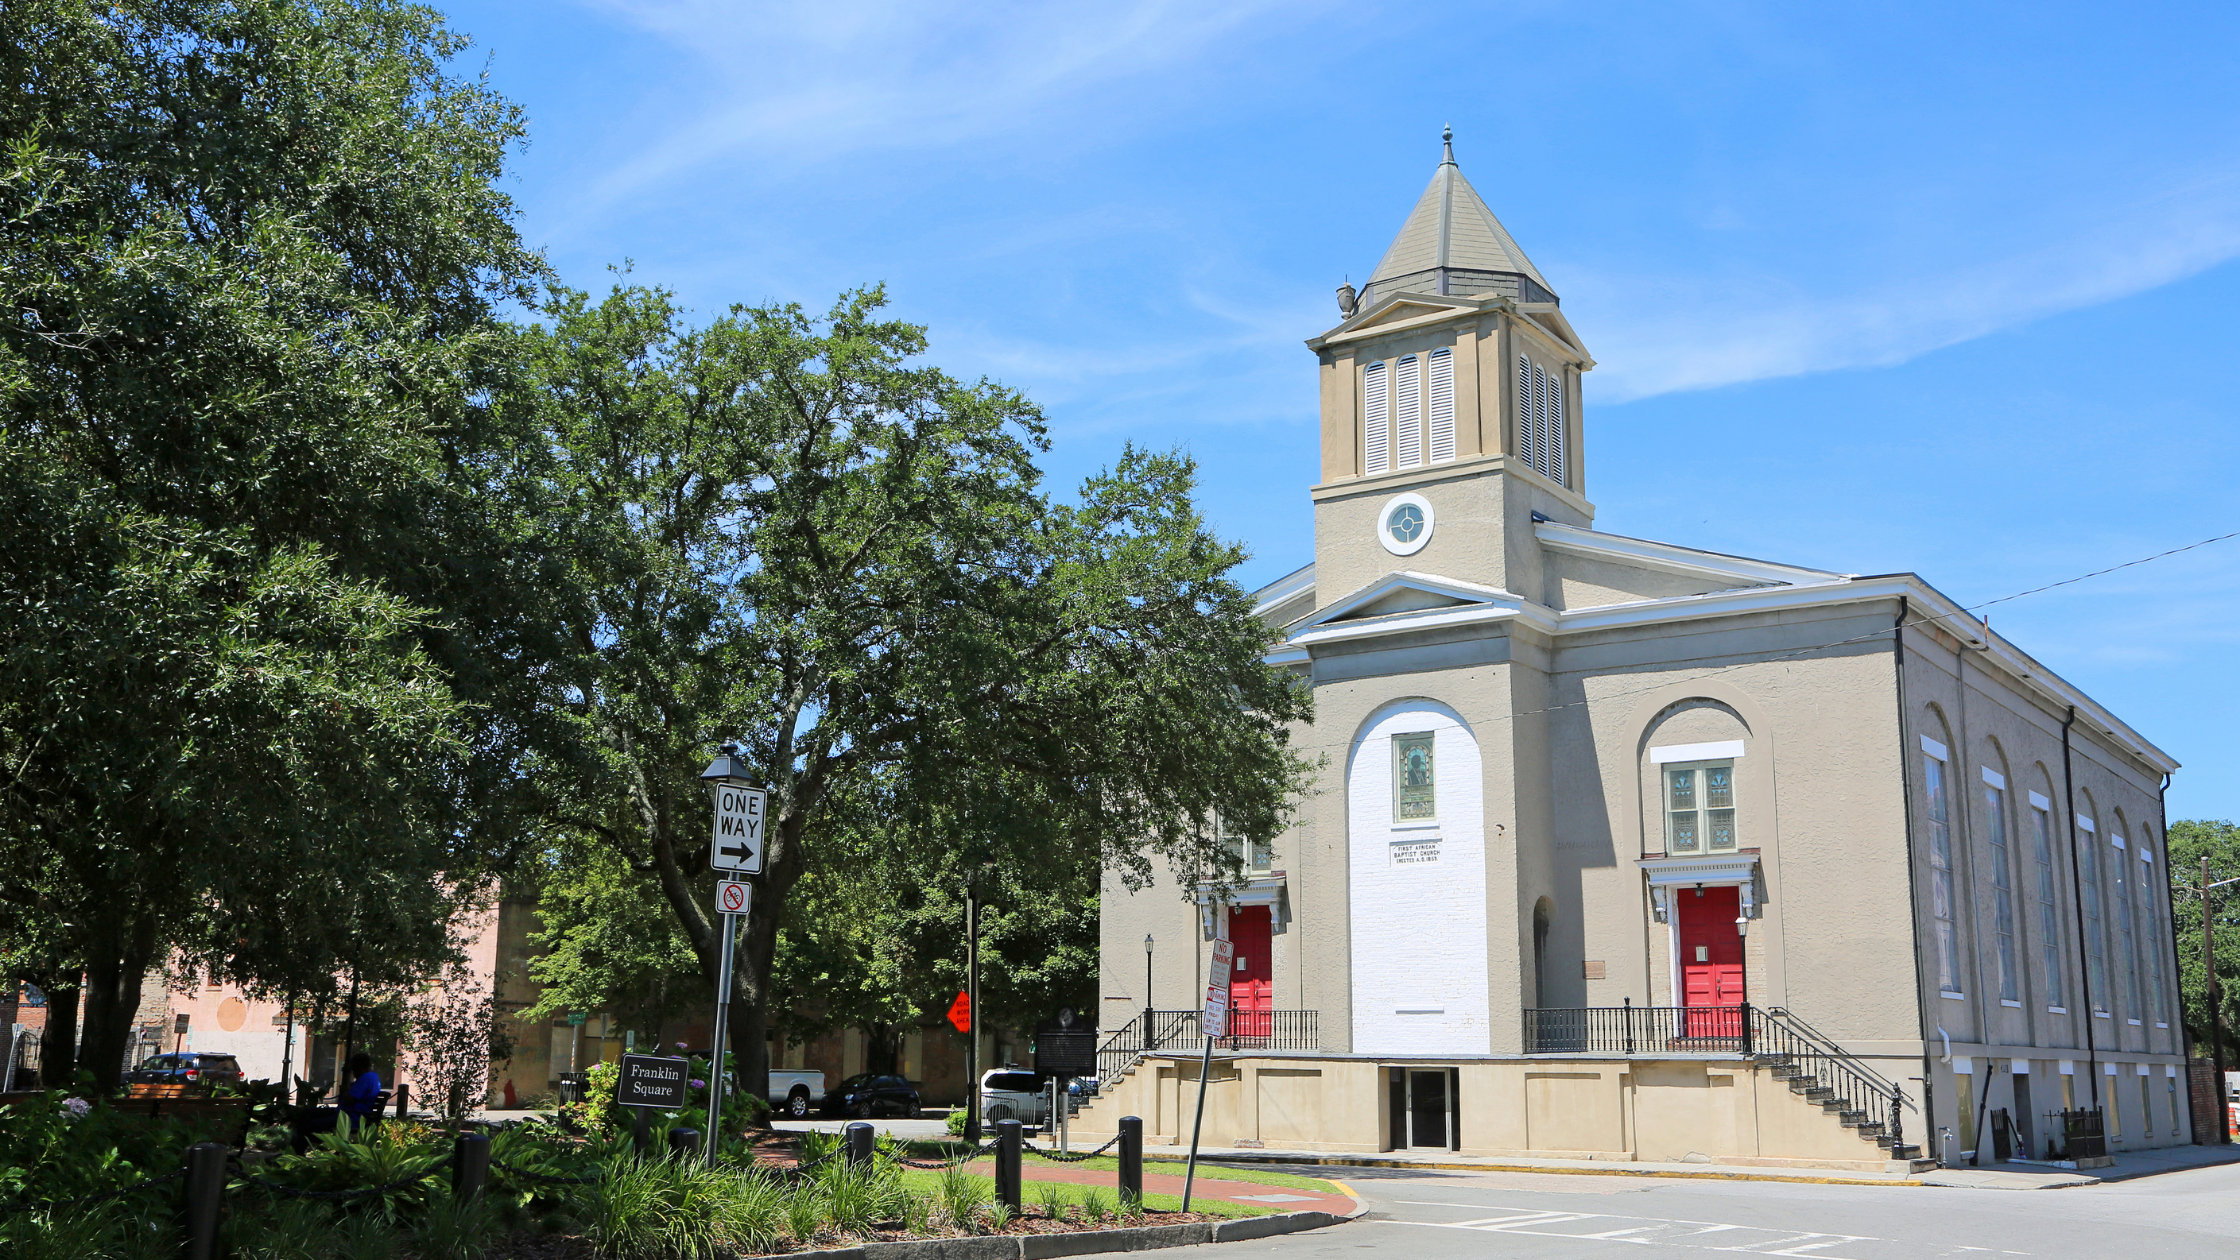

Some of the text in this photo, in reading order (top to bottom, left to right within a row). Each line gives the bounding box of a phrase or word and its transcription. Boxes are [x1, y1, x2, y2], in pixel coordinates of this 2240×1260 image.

[723, 793, 759, 815] ONE
[721, 816, 759, 838] WAY
[1219, 943, 1227, 953] NO
[1213, 953, 1231, 965] PARKING
[631, 1064, 679, 1080] Franklin
[633, 1081, 672, 1097] Square
